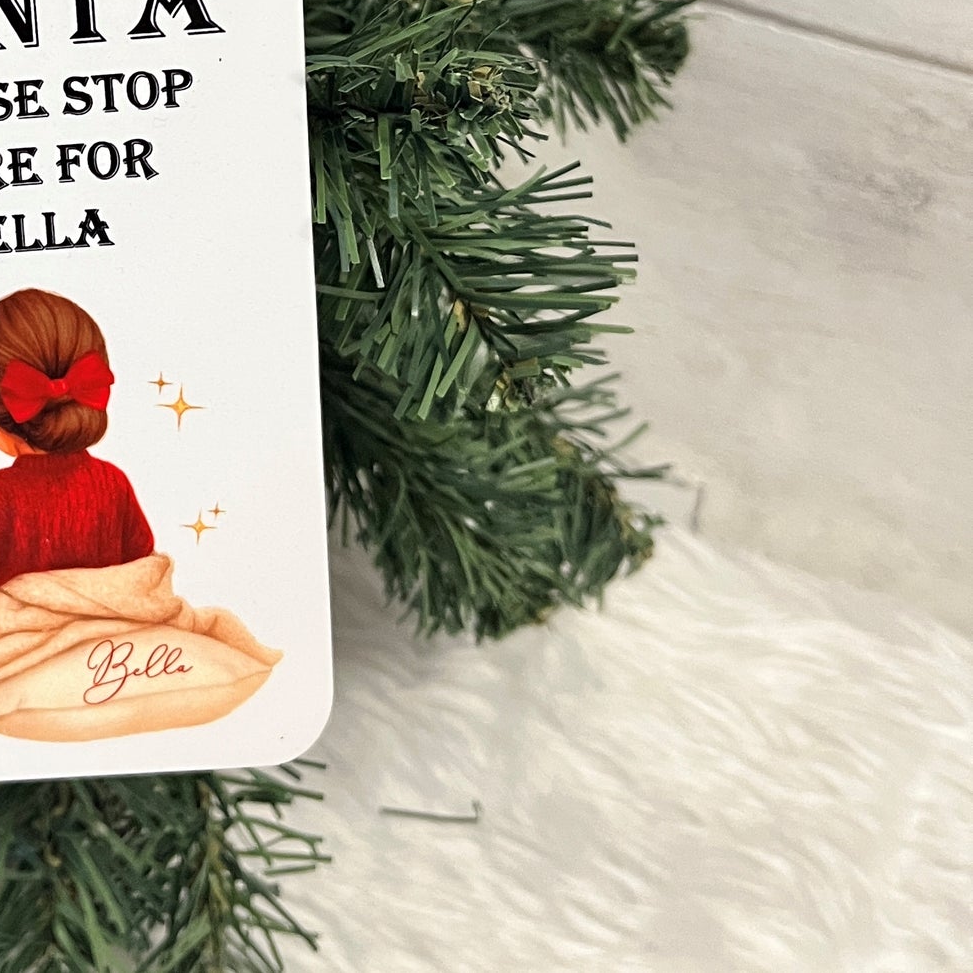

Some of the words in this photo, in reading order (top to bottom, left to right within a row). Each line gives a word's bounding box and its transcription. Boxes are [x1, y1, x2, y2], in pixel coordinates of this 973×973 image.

[62, 69, 193, 116] STOP
[56, 138, 159, 183] FOR
[82, 639, 194, 706] Bella
